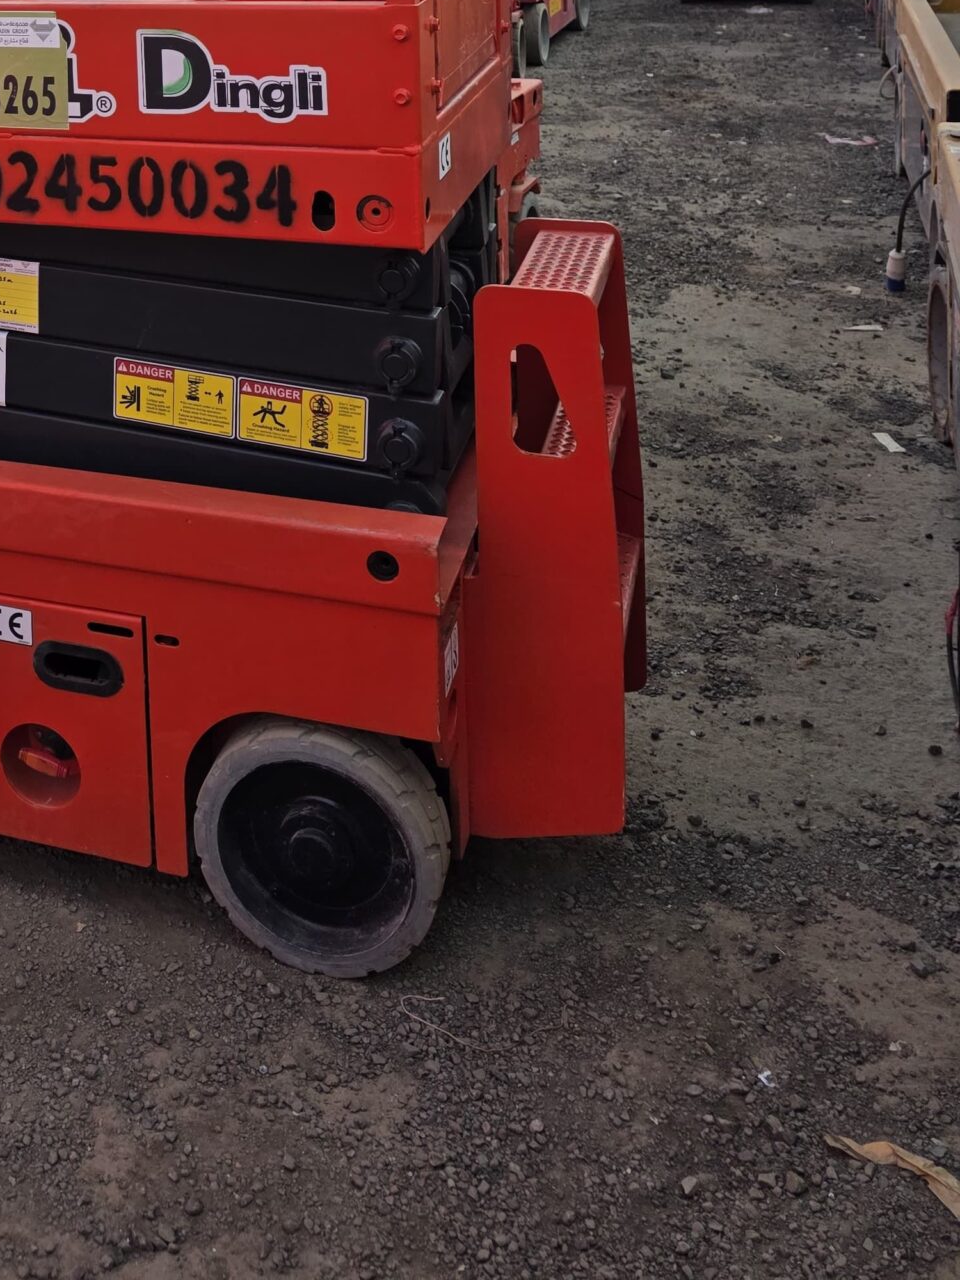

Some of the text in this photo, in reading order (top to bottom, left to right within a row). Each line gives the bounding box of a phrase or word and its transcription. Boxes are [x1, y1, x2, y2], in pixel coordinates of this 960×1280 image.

[142, 33, 324, 118] Dingli
[129, 363, 173, 380] DANGER
[254, 383, 300, 400] DANGER
